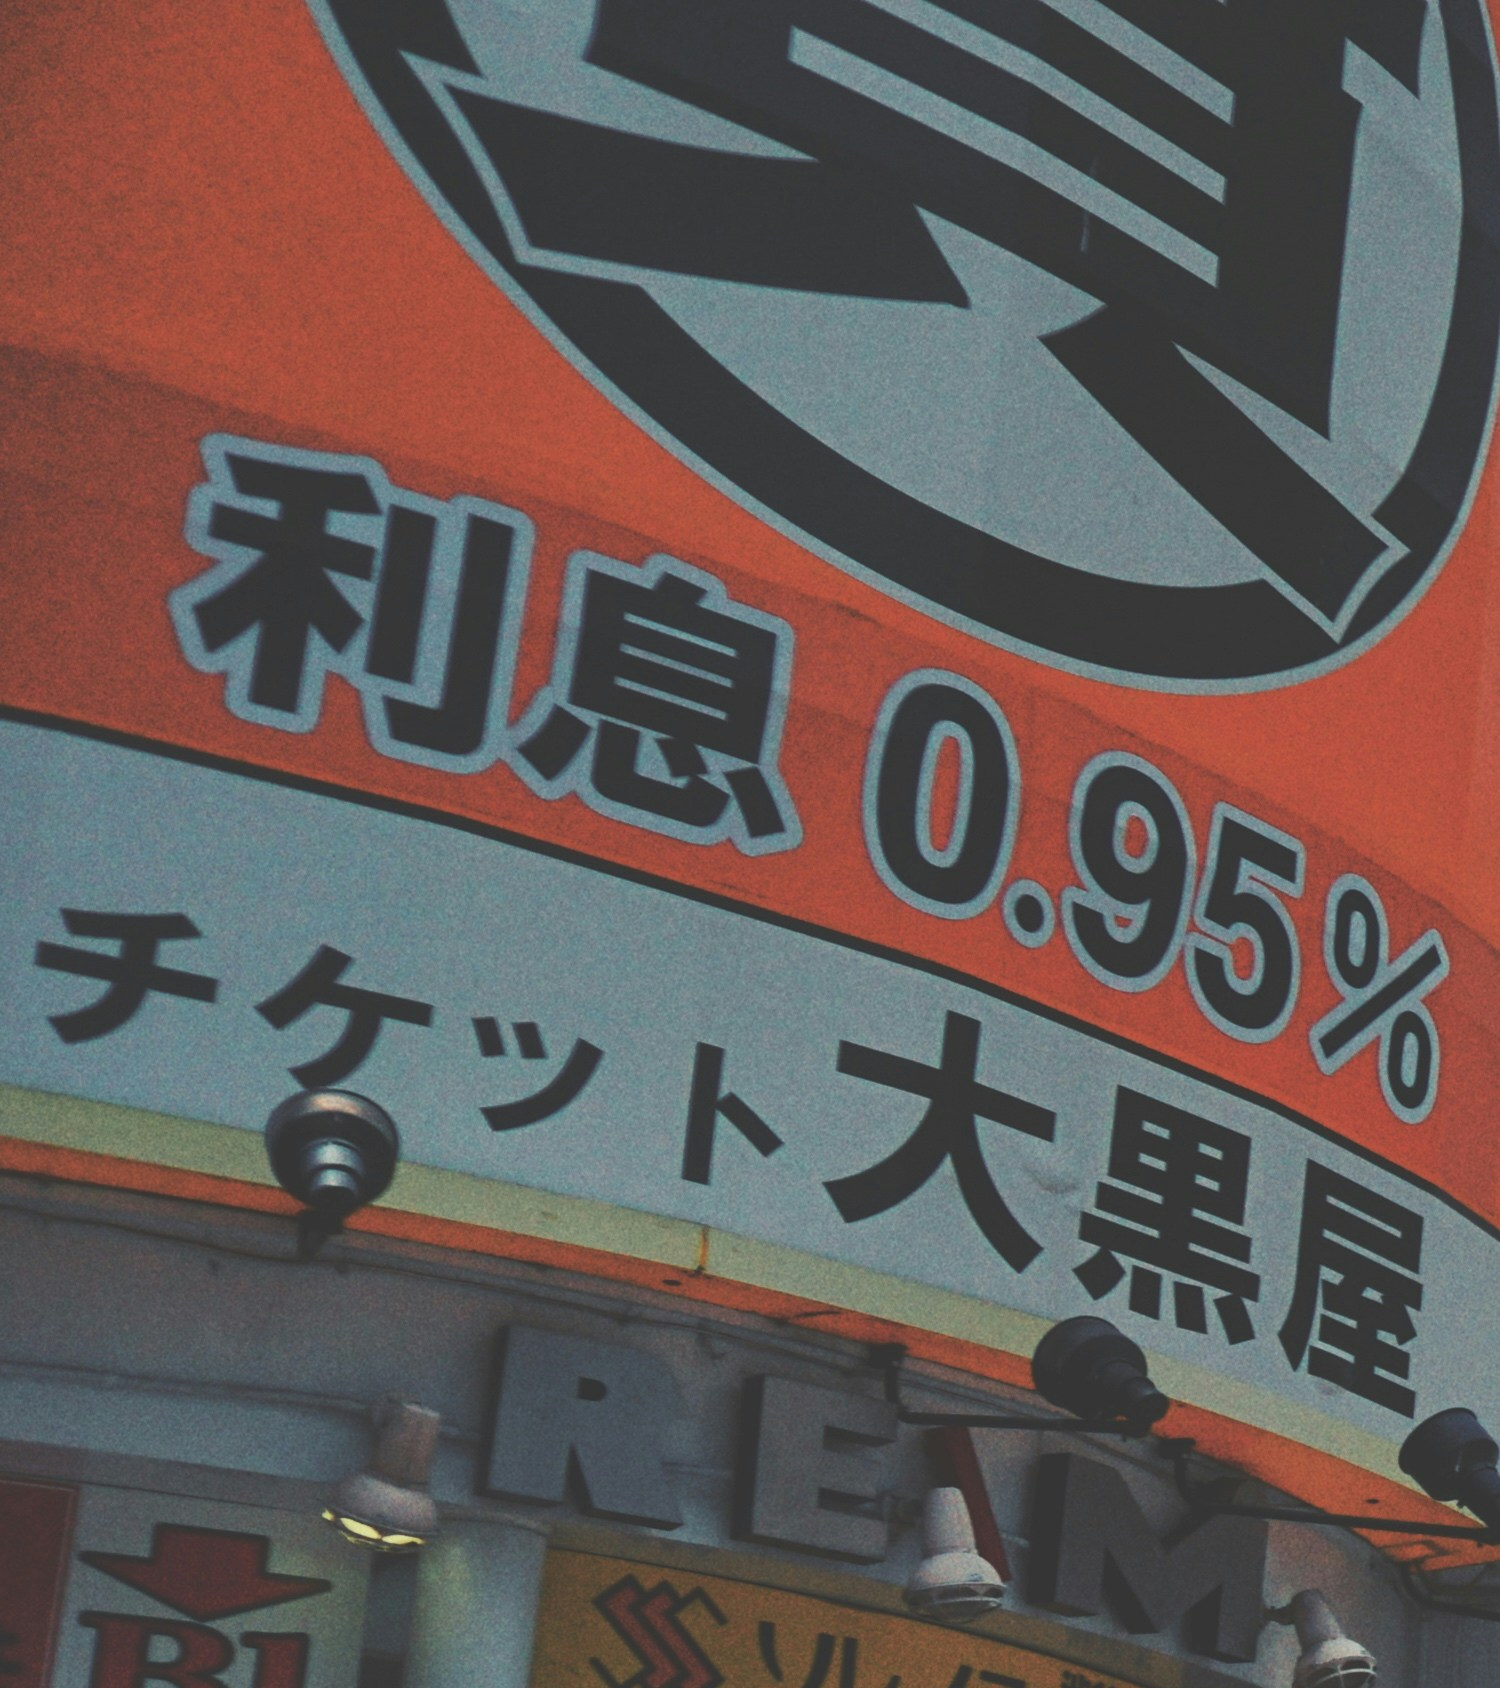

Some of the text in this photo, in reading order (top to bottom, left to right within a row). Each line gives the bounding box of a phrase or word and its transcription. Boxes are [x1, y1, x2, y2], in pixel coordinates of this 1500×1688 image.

[169, 432, 1450, 1122] 利息 0.95%
[33, 907, 1427, 1418] チケット大黒屋
